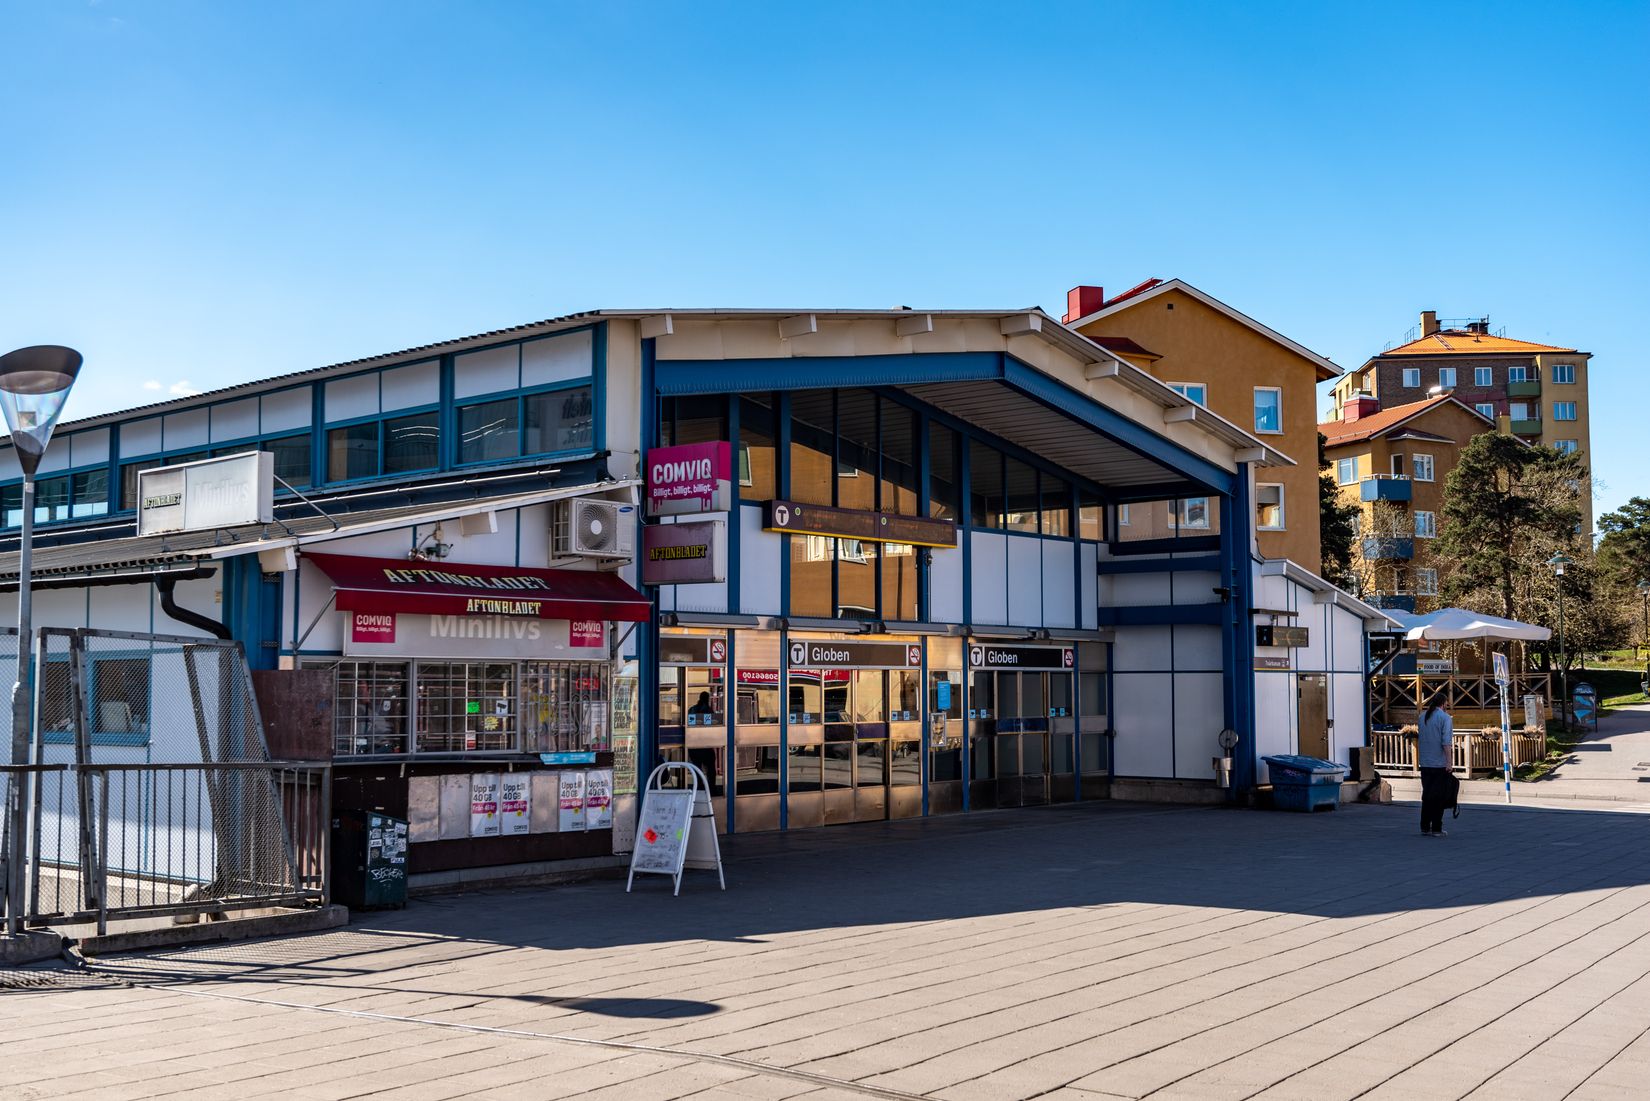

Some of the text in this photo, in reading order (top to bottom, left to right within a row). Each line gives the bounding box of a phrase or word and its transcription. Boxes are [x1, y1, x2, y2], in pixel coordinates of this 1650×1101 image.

[653, 459, 712, 485] COMVIQ
[650, 544, 707, 560] AFTONBLADET
[383, 568, 550, 590] AFTONBLADET
[466, 598, 542, 615] AFTONBLADET
[356, 614, 392, 626] COMVIQ
[430, 615, 540, 640] Minilivs
[572, 622, 601, 632] COMVIQ
[812, 648, 850, 662] Globen
[988, 650, 1018, 664] Globen
[474, 784, 487, 793] Upp
[504, 784, 516, 792] Upp
[562, 782, 573, 790] Upp
[589, 780, 600, 789] Upp
[473, 794, 483, 802] 40
